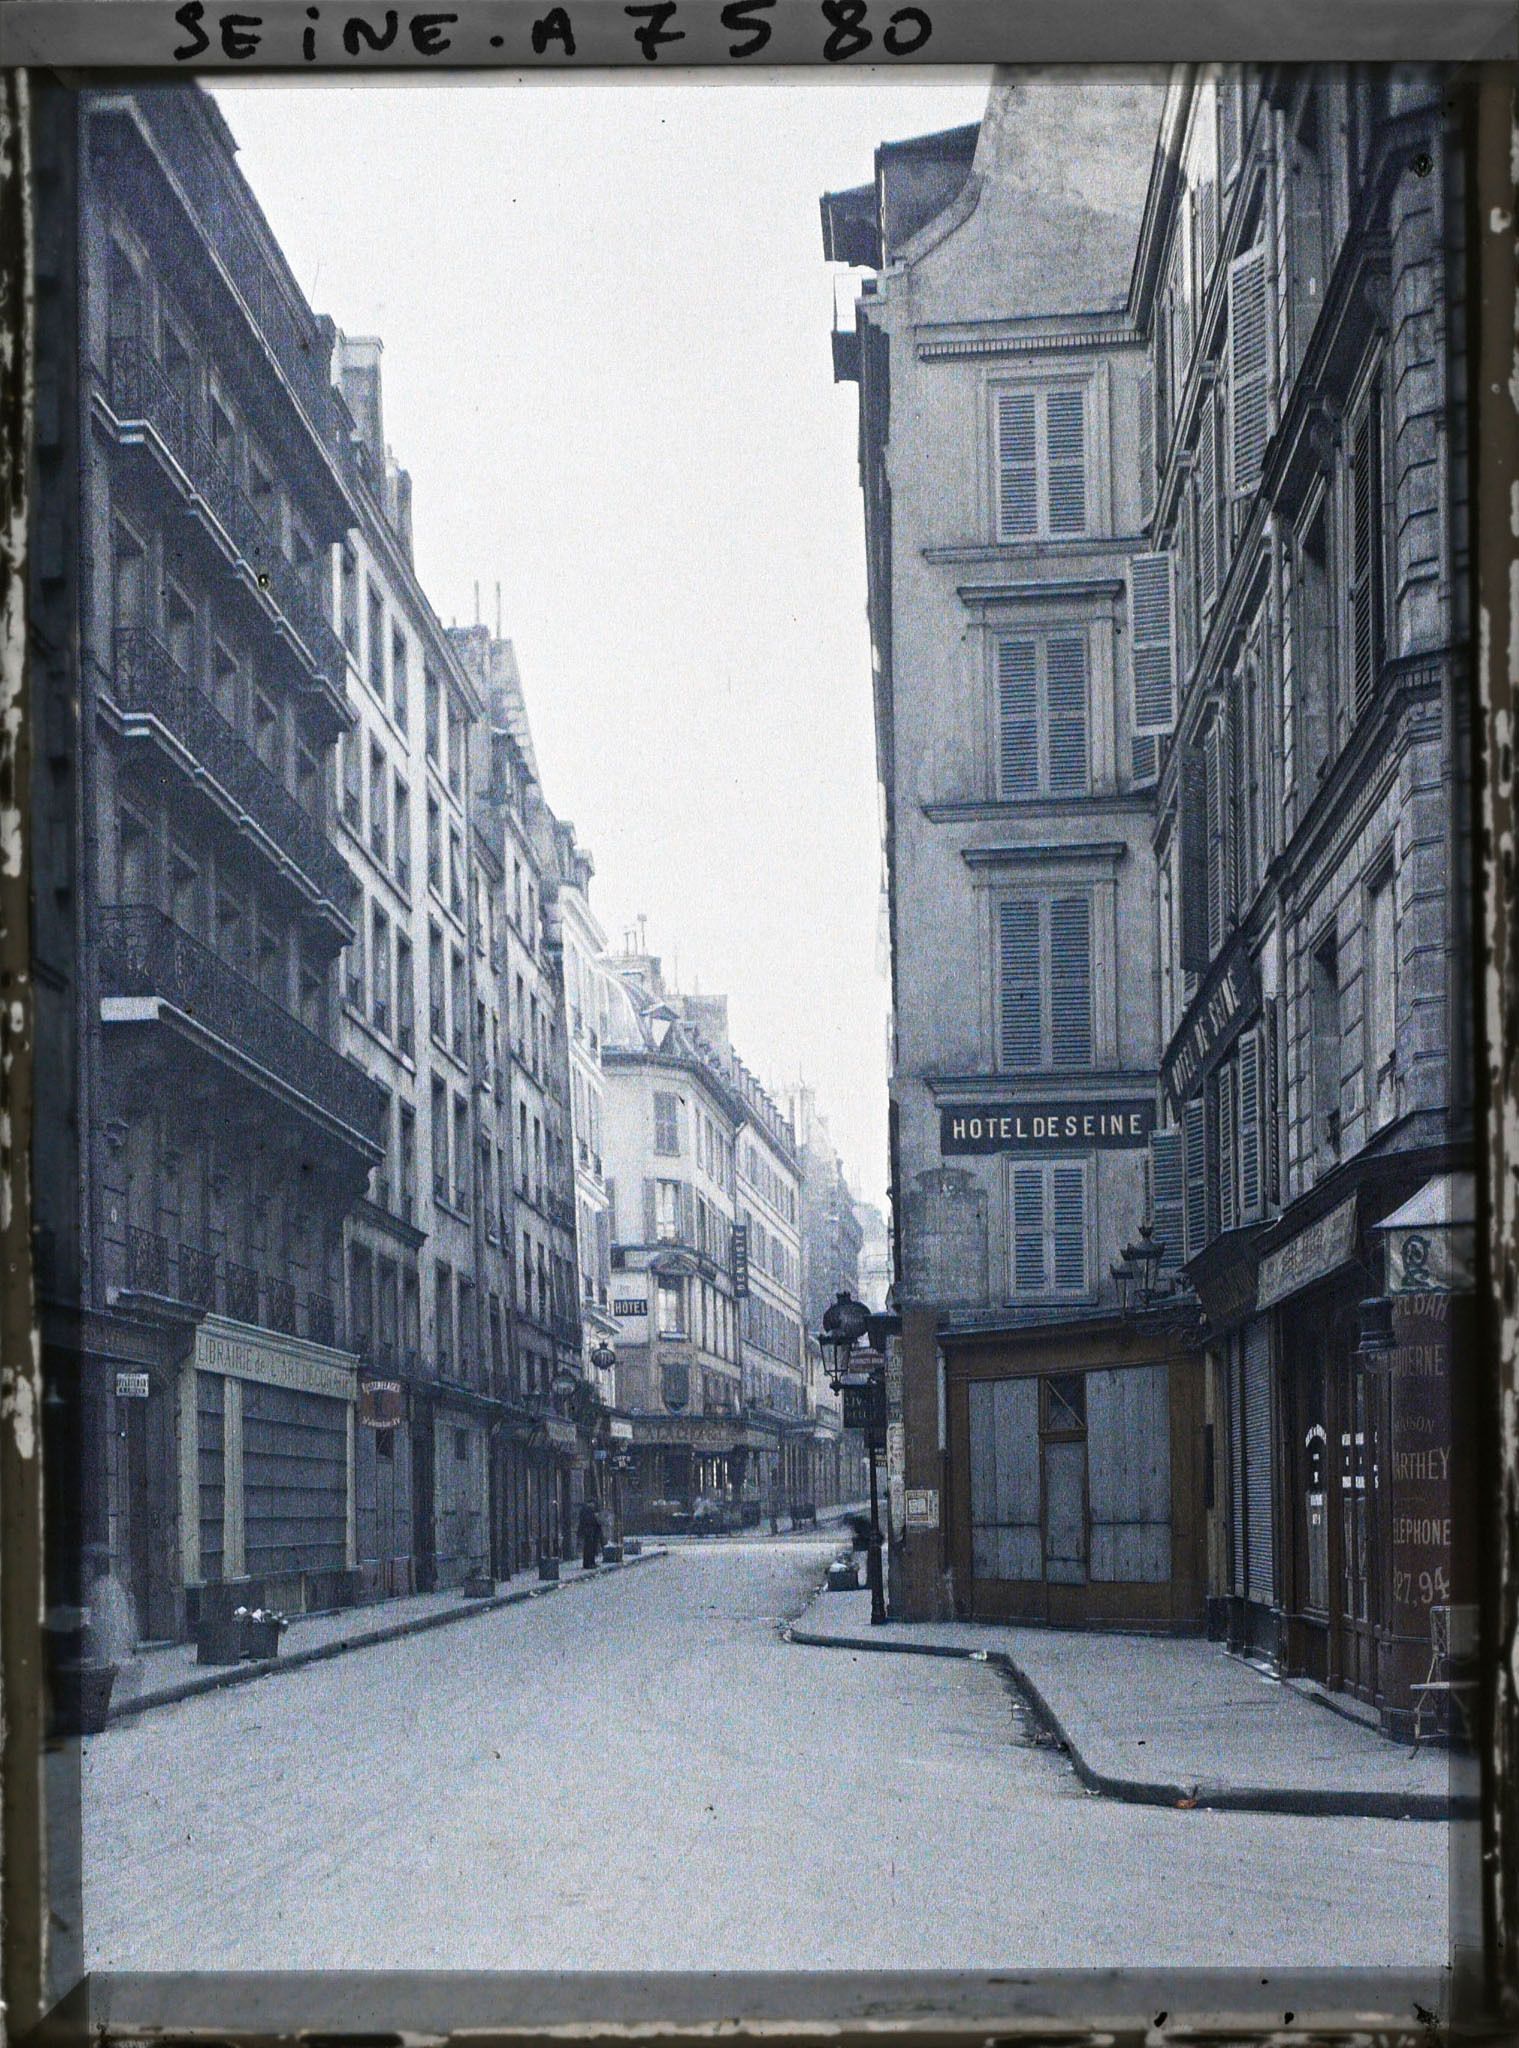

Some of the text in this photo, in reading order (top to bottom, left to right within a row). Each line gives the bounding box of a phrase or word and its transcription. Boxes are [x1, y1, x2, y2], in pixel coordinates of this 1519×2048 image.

[953, 1113, 1142, 1140] HOTEL DE SEINE
[735, 1231, 746, 1291] DENTISTE
[197, 1336, 252, 1373] LIBRAIRIE
